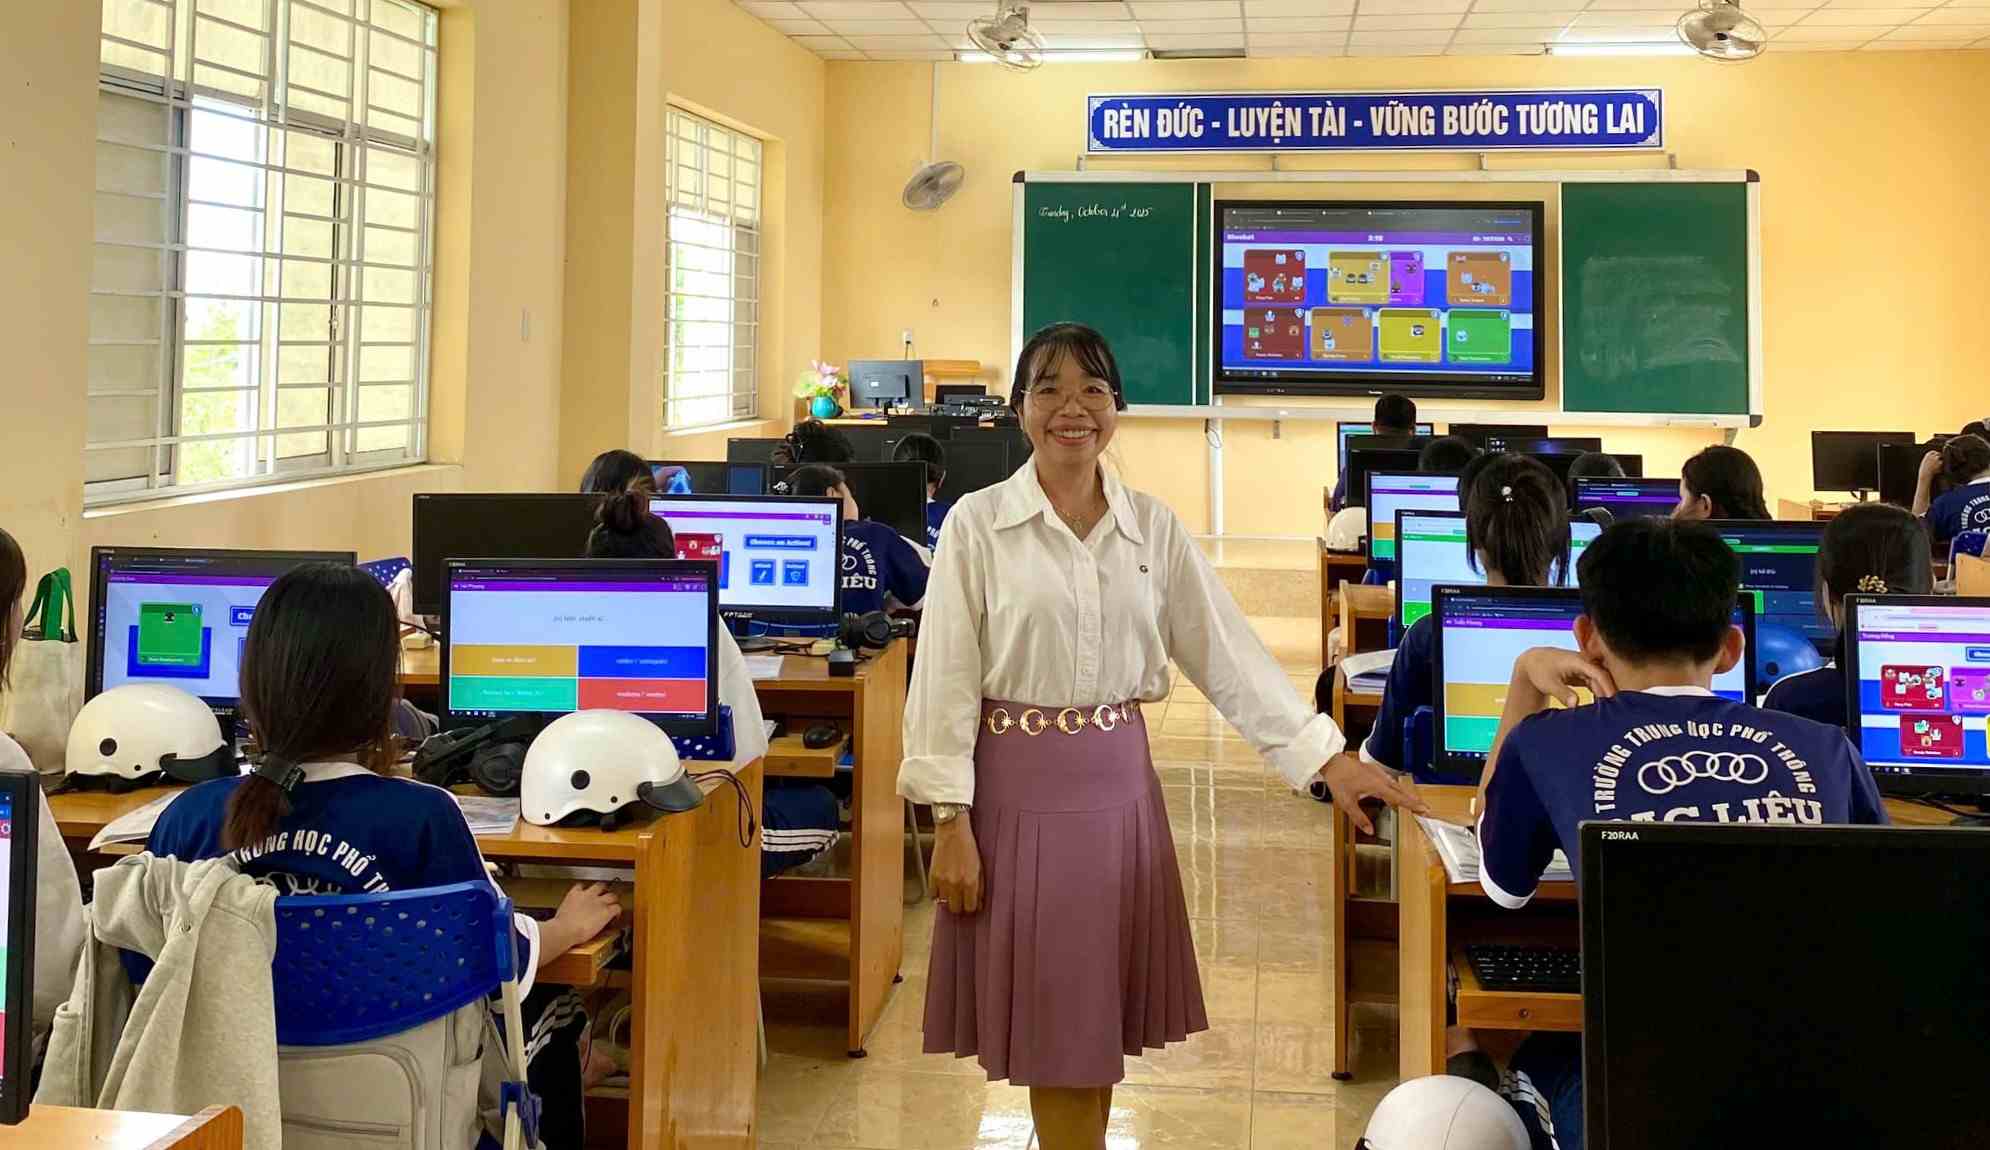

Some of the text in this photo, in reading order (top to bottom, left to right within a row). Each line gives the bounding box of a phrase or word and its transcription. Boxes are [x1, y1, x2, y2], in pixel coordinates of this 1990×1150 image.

[1103, 102, 1150, 138] RÈN
[1157, 102, 1204, 138] ĐỨC
[1228, 101, 1302, 144] LUYỆN
[1309, 100, 1346, 137] TÀI
[1353, 120, 1363, 128] -
[1370, 100, 1435, 136] VỮNG
[1443, 98, 1509, 136] BƯỚC
[1516, 100, 1598, 135] TƯƠNG
[1607, 102, 1644, 134] LAI
[1078, 203, 1108, 217] October
[841, 573, 877, 590] IÊU
[1593, 744, 1632, 814] TRƯỜNG
[1624, 722, 1684, 747] TRUNG
[1687, 720, 1723, 739] HỌC
[1770, 742, 1817, 794] THÔNG
[1712, 790, 1822, 824] LIÊU
[1601, 831, 1640, 840] F20RAA
[292, 829, 332, 856] HỌC
[331, 840, 377, 877] PHỔ
